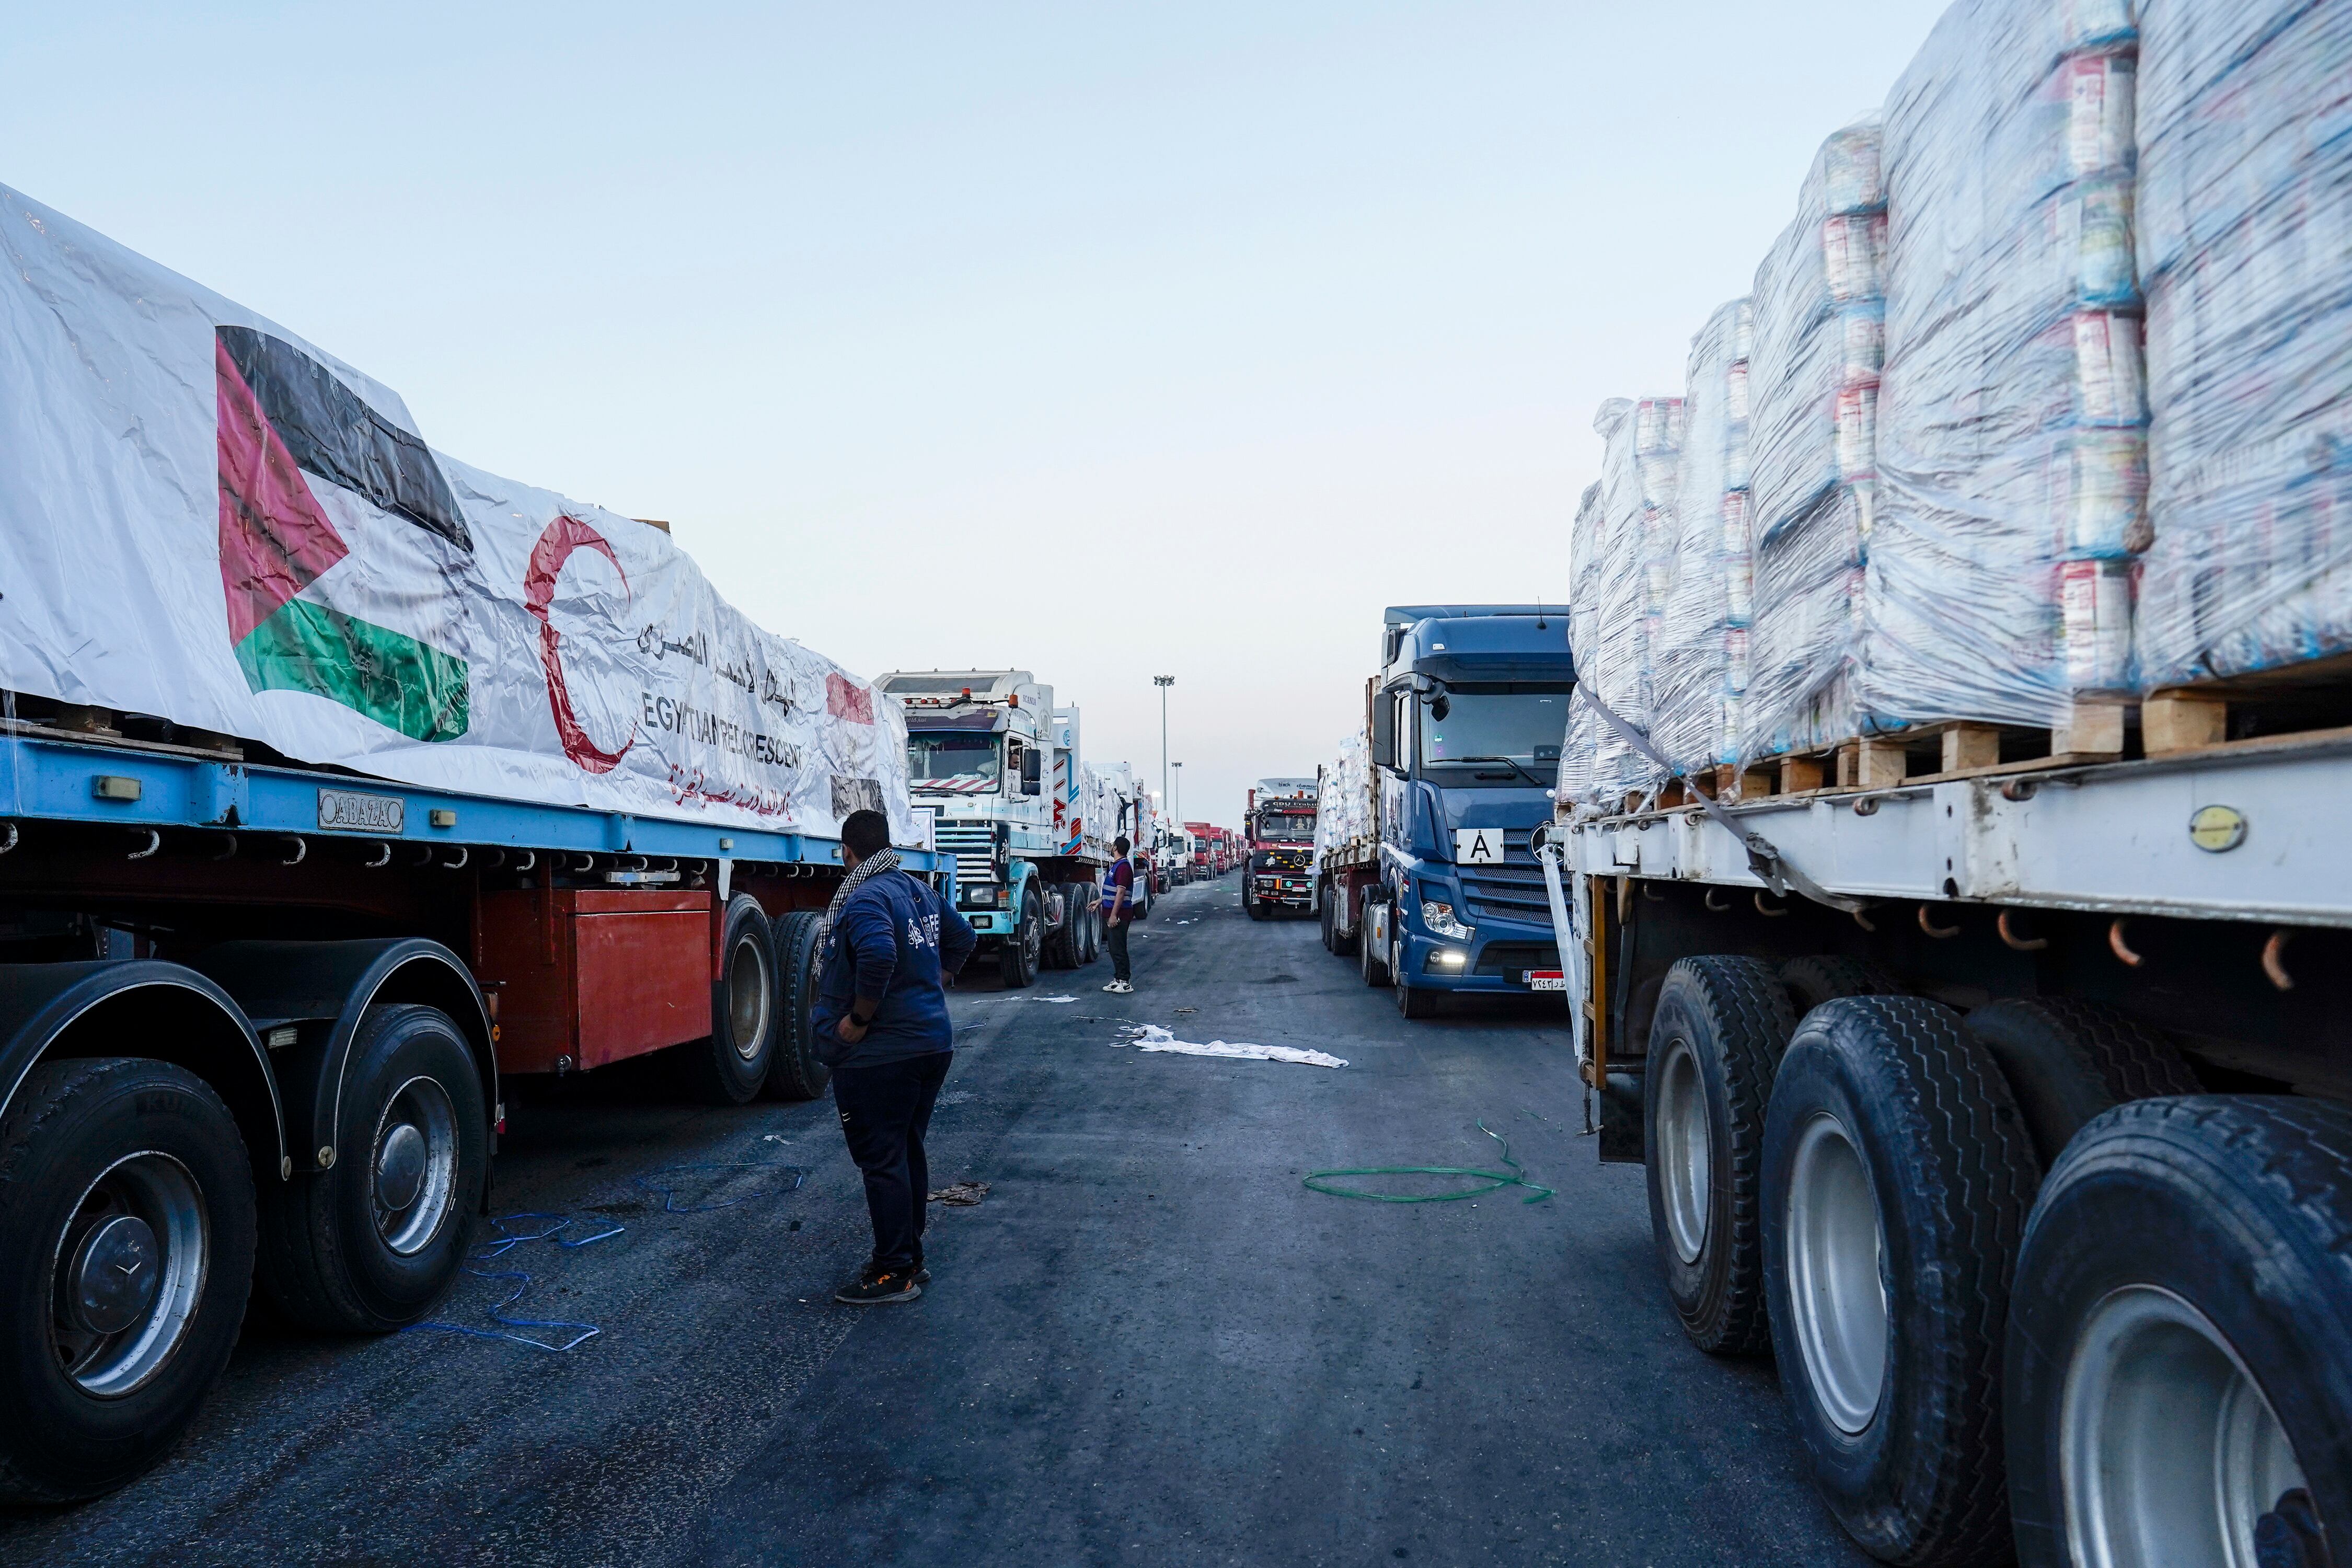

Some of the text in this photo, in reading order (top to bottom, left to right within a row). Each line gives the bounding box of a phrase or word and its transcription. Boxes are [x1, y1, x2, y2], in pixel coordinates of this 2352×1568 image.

[1022, 695, 1036, 706] SCANIA
[743, 729, 802, 770] CRESCENT
[337, 796, 388, 827] ABAZA
[1470, 835, 1491, 858] A
[1532, 980, 1552, 988] ٧٢٤٣
